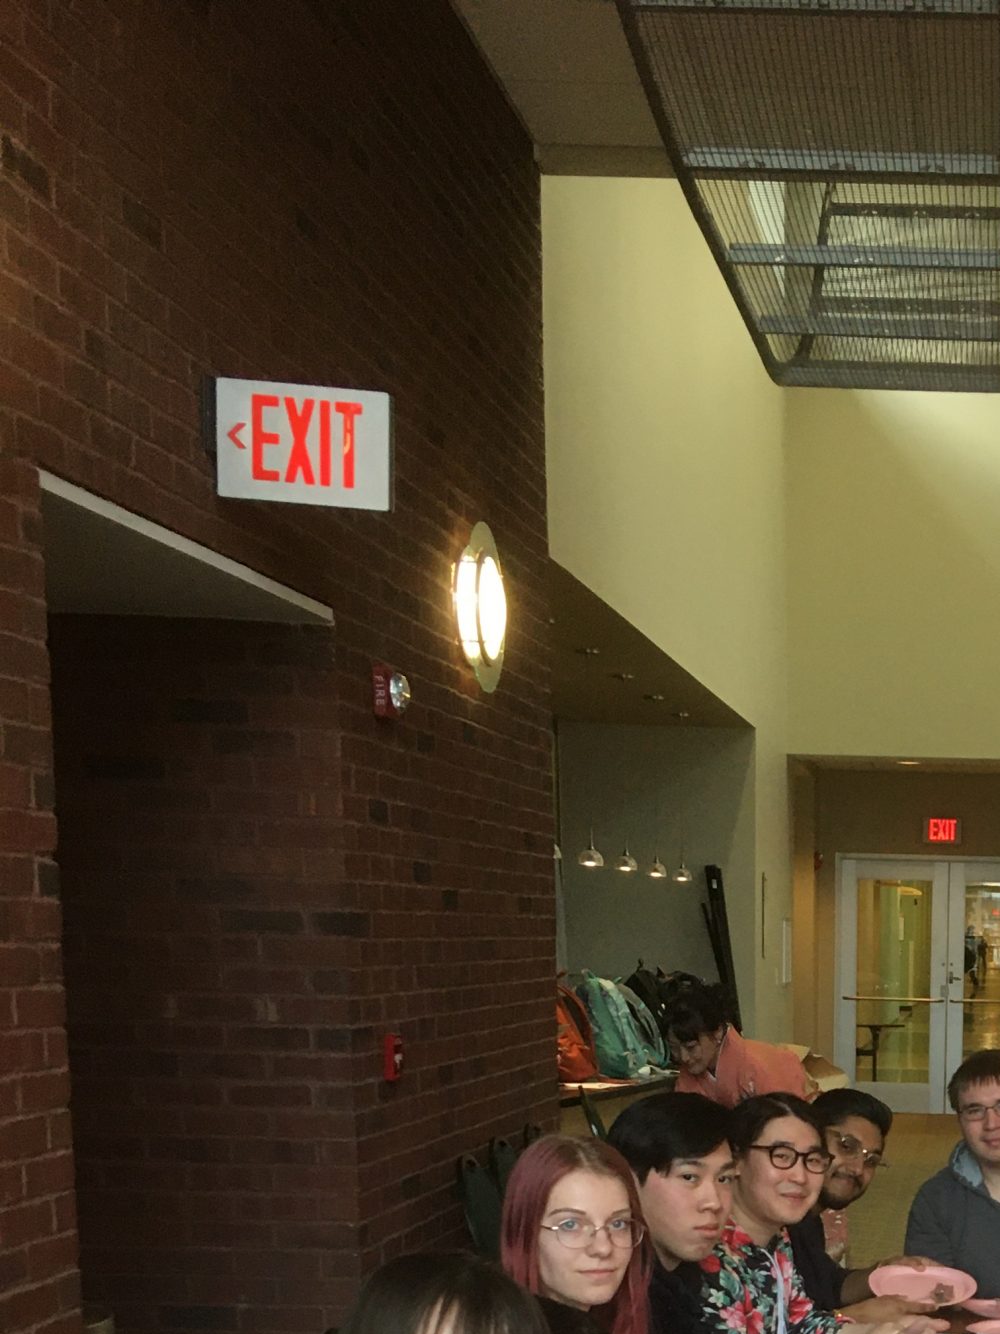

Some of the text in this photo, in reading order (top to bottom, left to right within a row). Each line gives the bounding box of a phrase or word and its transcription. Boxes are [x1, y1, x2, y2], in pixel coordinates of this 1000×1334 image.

[252, 394, 363, 489] EXIT
[374, 674, 386, 706] FIRE
[929, 818, 957, 841] EXIT
